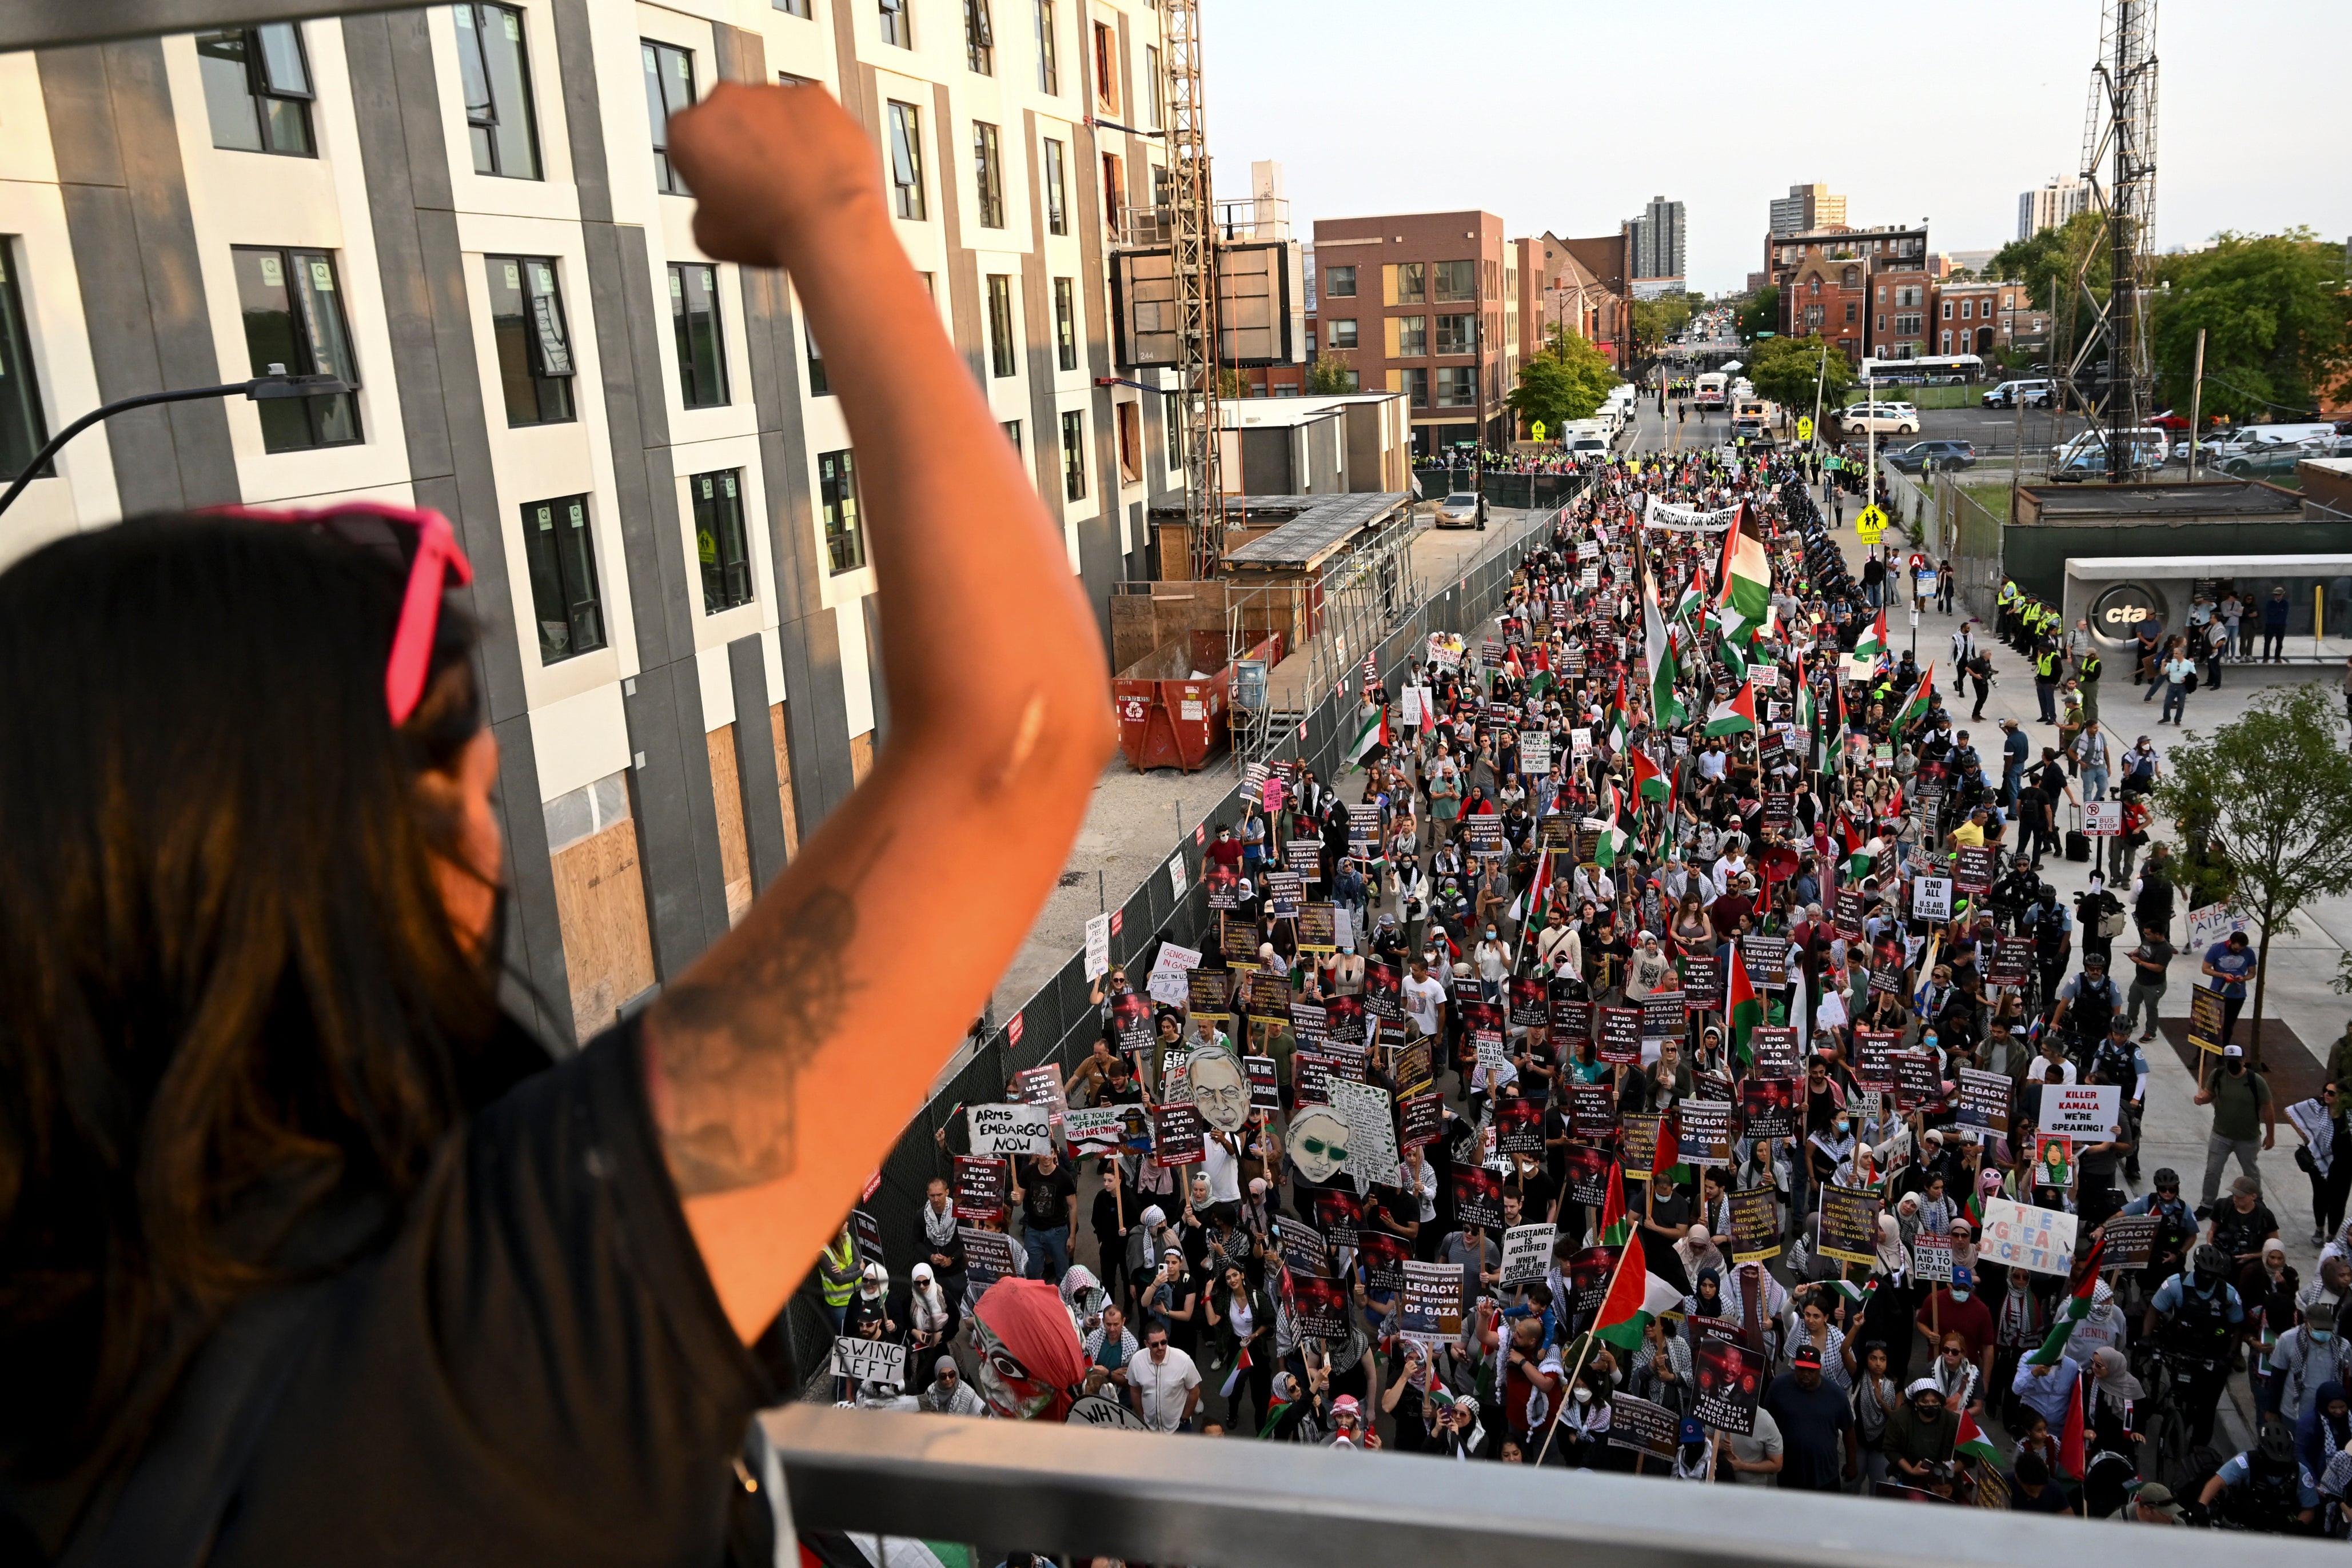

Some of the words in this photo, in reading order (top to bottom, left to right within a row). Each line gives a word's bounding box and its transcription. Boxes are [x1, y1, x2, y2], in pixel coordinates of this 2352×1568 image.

[1653, 506, 1687, 525] CHRISTIANS
[1691, 516, 1703, 526] FOR
[1912, 556, 1920, 565] A
[2106, 605, 2146, 623] cta
[1769, 736, 1781, 744] NOT
[1762, 748, 1784, 759] GENOCIDE
[1909, 845, 1923, 856] LET
[1925, 880, 1942, 889] END
[1088, 918, 1105, 931] NOBODY'S
[1092, 929, 1102, 937] FREE
[1087, 944, 1107, 959] EVERYBODY'S
[1164, 948, 1198, 964] GENOCIDE
[1093, 956, 1102, 965] FREE
[1249, 1064, 1259, 1074] THE
[1261, 1066, 1272, 1075] DNC
[1253, 1085, 1277, 1095] CHICAGO!
[2059, 1102, 2099, 1110] KAMALA
[975, 1110, 1013, 1123] ARMS
[1063, 1112, 1089, 1123] WHILE
[1090, 1111, 1115, 1119] YOU'RE
[1682, 1115, 1727, 1126] LEGACY:
[2064, 1112, 2092, 1121] WE'RE
[1074, 1118, 1114, 1130] SPEAKING
[2052, 1123, 2103, 1132] SPEAKING!
[980, 1123, 1049, 1138] EMBARGO
[1067, 1130, 1086, 1139] THEY
[1086, 1128, 1099, 1136] ARE
[1100, 1125, 1123, 1134] DYING
[1163, 1132, 1197, 1143] ISRAEL
[1681, 1133, 1696, 1142] OF
[1698, 1136, 1727, 1144] GAZA
[993, 1138, 1030, 1151] NOW
[961, 1188, 996, 1197] ISRAEL
[1827, 1203, 1866, 1215] DEMOCRATS
[1828, 1211, 1872, 1224] REPUBLICANS
[2015, 1206, 2053, 1230] THE
[1823, 1219, 1839, 1228] HAVE
[1841, 1223, 1863, 1232] BLOOD
[1506, 1227, 1554, 1240] RESISTANCE
[1828, 1228, 1845, 1238] THEIR
[1995, 1221, 2063, 1251] GREAT
[962, 1237, 988, 1246] GENOCIDE
[1525, 1237, 1533, 1245] IS
[1915, 1240, 1951, 1248] PALESTINE!
[964, 1244, 1008, 1257] LEGACY:
[1509, 1243, 1547, 1255] JUSTIFIED
[1980, 1237, 2072, 1272] DECEPTION
[981, 1255, 1011, 1264] BUTCHER
[1516, 1256, 1537, 1264] WHEN
[967, 1261, 982, 1269] OF
[984, 1263, 1013, 1274] GAZA
[1505, 1264, 1533, 1274] PEOPLE
[1533, 1262, 1547, 1270] ARE
[1918, 1263, 1950, 1273] ISRAEL!
[1406, 1274, 1438, 1282] GENOCIDE
[1506, 1270, 1543, 1280] OCCUPIED!
[1406, 1282, 1459, 1294] LEGACY:
[1422, 1296, 1458, 1304] BUTCHER
[1405, 1304, 1421, 1314] OF
[1425, 1306, 1458, 1316] GAZA
[2079, 1328, 2108, 1340] JENIN
[835, 1338, 903, 1363] SWING
[839, 1359, 896, 1379] LEFT
[1700, 1394, 1748, 1414] DEMOCRATS
[1074, 1403, 1125, 1425] WHY
[1696, 1405, 1736, 1423] GENOCIDE
[1737, 1418, 1749, 1427] OF
[1704, 1402, 1723, 1413] FUND
[1727, 1411, 1741, 1419] THE
[1693, 1410, 1750, 1433] PALESTINIANS
